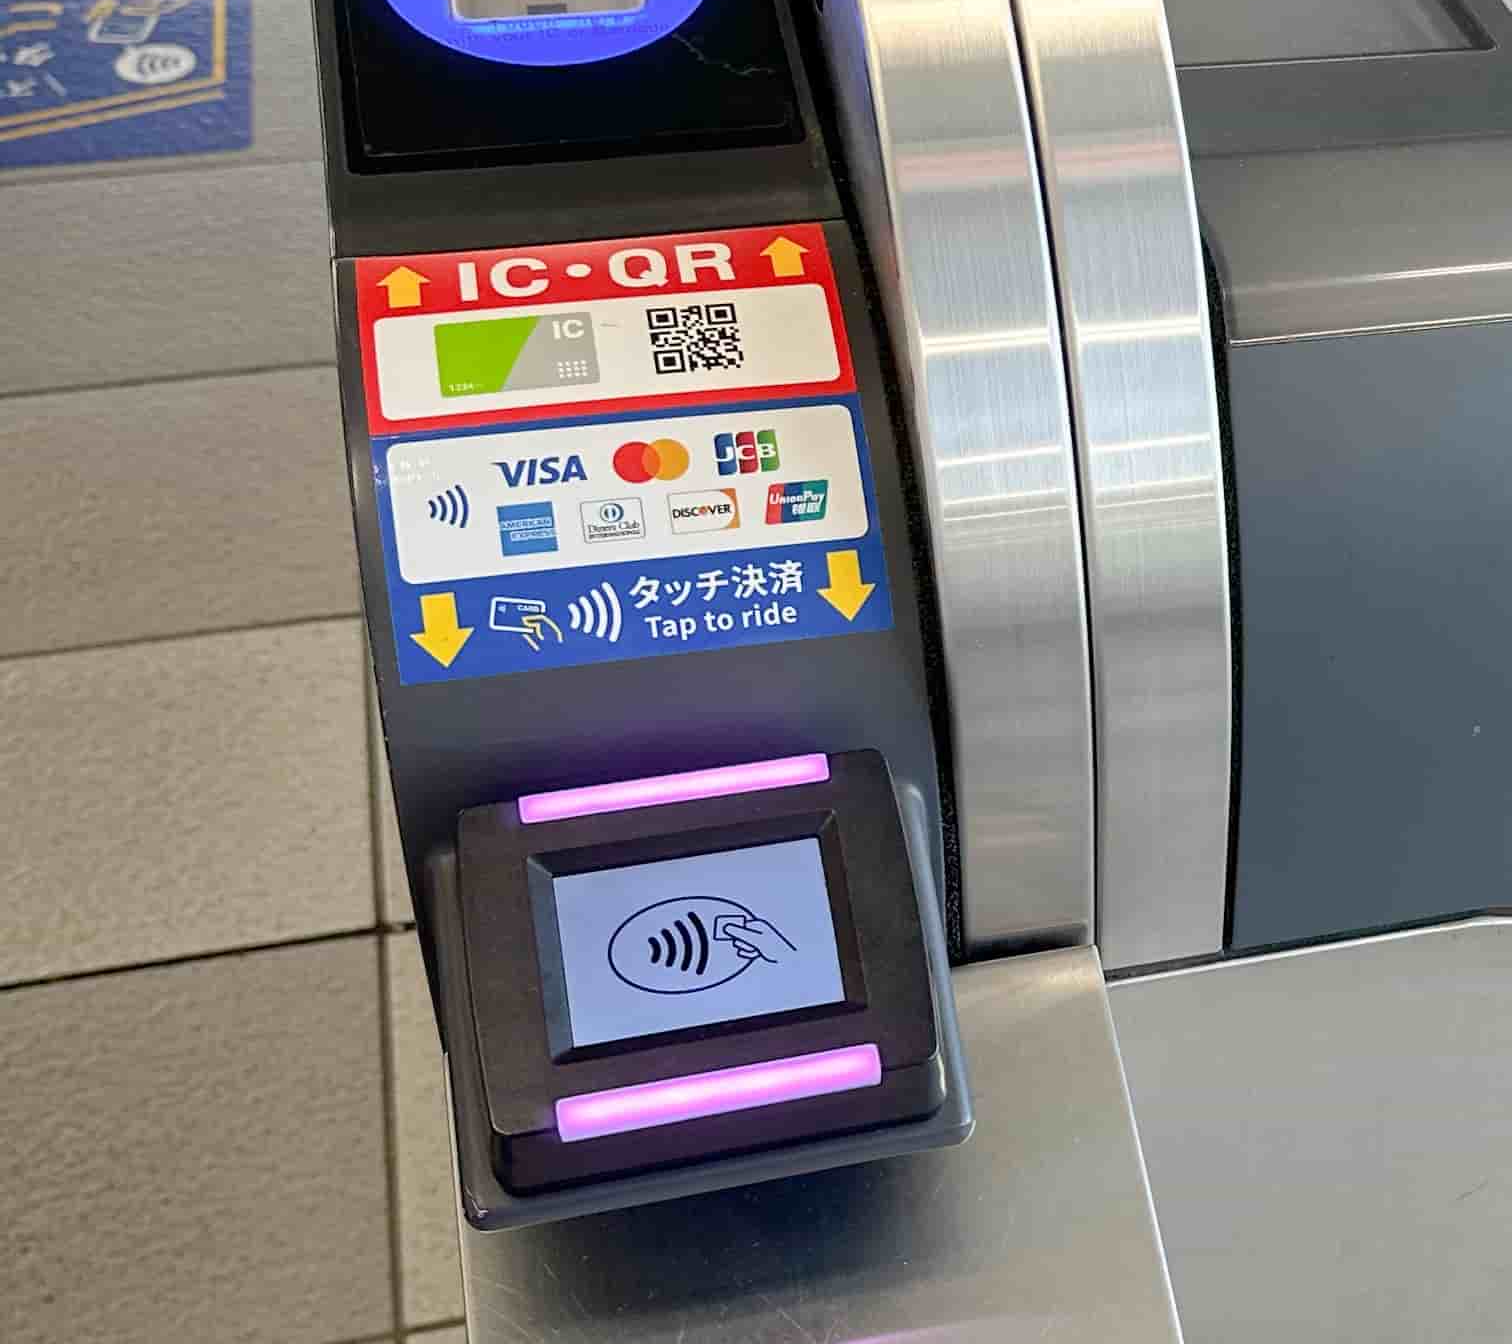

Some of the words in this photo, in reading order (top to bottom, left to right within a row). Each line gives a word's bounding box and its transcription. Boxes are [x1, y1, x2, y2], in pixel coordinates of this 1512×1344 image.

[552, 319, 585, 340] IC
[492, 454, 588, 489] VISA
[672, 504, 731, 519] DISCOVER
[629, 560, 803, 608] タッチ決済
[645, 613, 697, 641] Tap
[704, 610, 735, 632] to
[742, 602, 798, 628] ride
